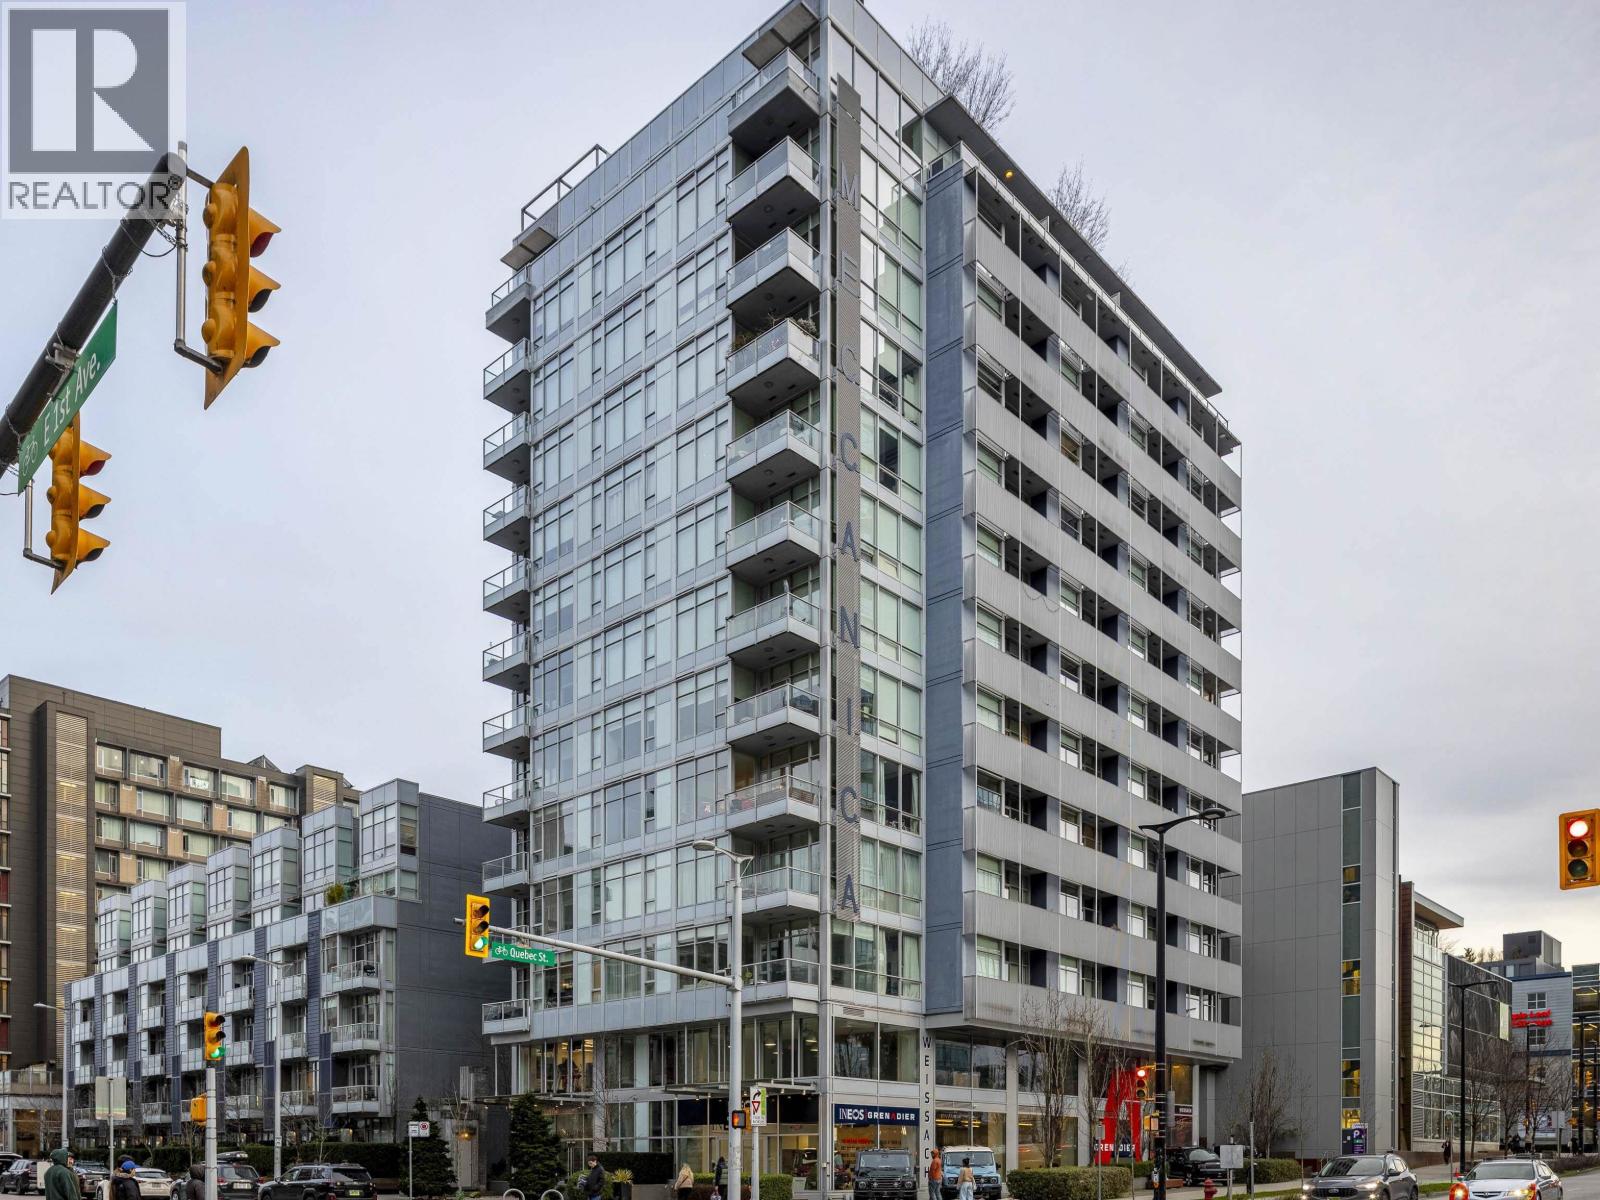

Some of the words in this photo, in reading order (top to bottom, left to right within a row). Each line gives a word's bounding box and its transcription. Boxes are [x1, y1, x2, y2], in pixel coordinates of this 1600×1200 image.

[44, 414, 50, 447] E
[53, 387, 71, 433] 1st
[75, 352, 101, 402] Ave.
[840, 160, 861, 913] MECCANICA
[510, 948, 537, 960] Quebec
[538, 952, 548, 963] St.
[839, 1107, 865, 1121] INEOS
[867, 1110, 916, 1121] GRENADIER
[922, 1036, 932, 1179] WEISSACH
[1093, 1143, 1136, 1152] GRENDIER
